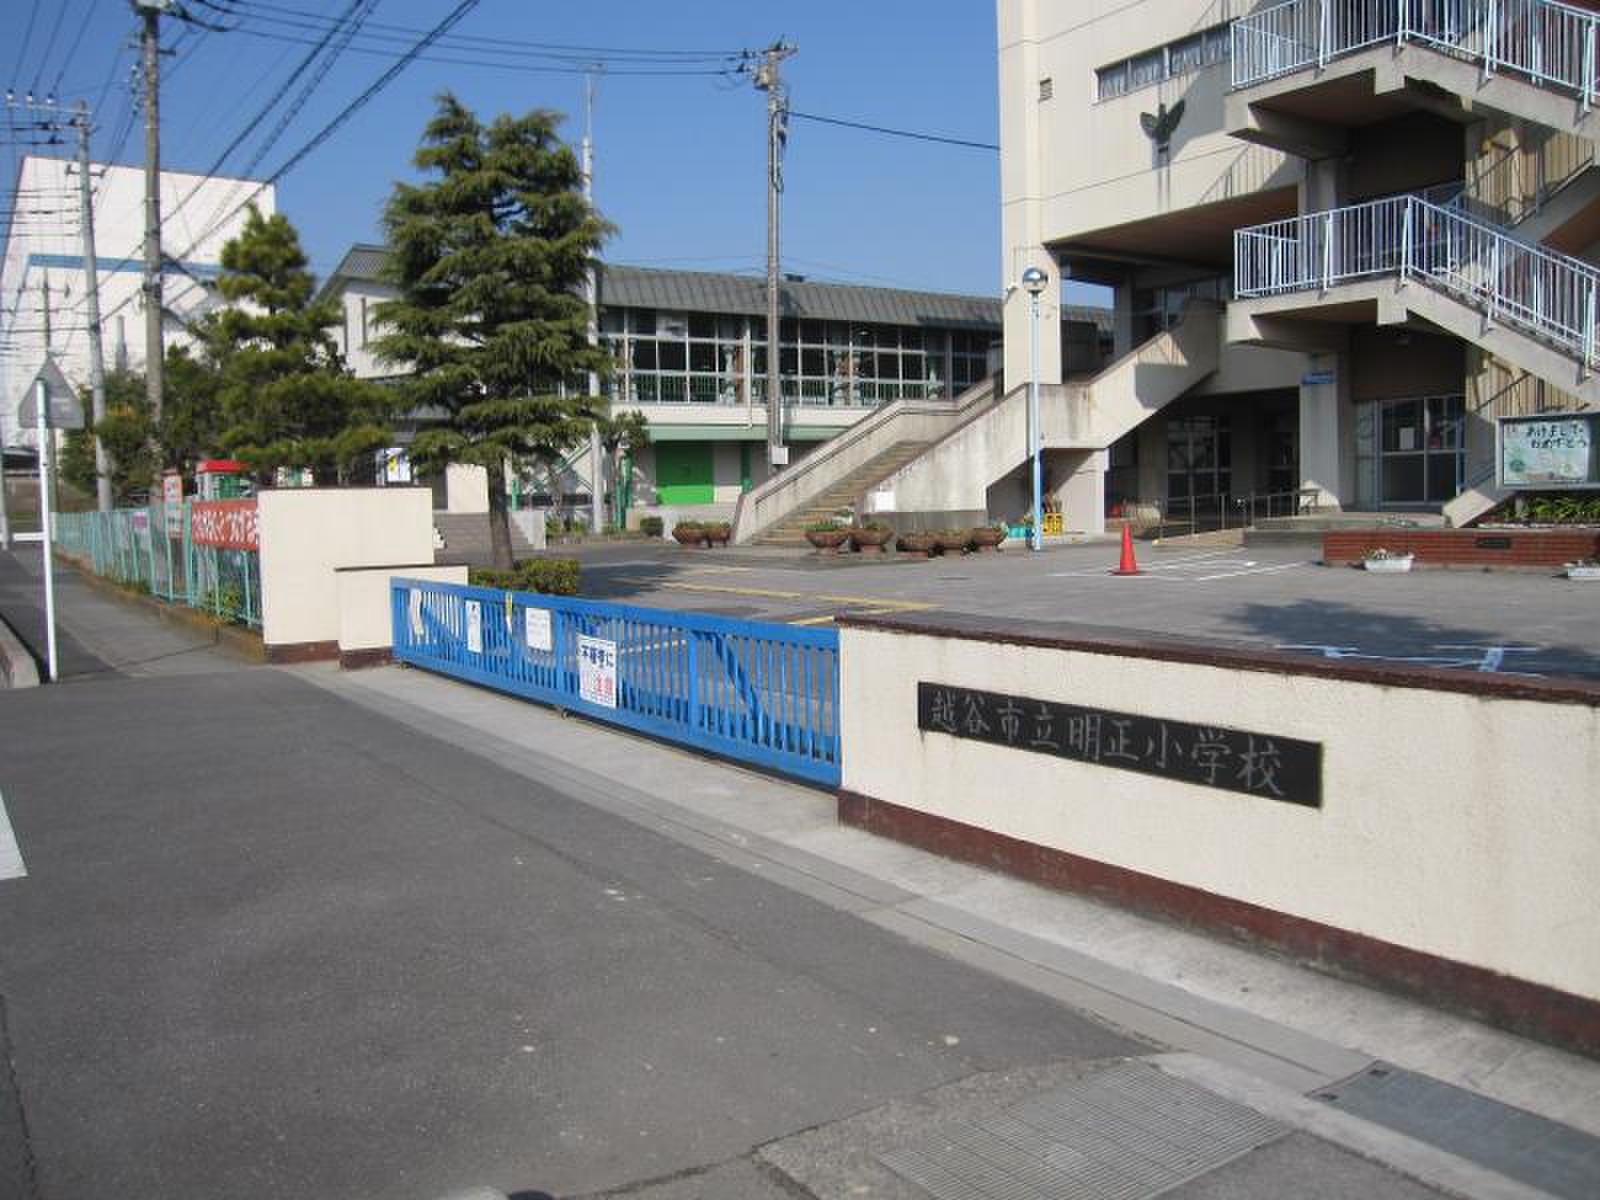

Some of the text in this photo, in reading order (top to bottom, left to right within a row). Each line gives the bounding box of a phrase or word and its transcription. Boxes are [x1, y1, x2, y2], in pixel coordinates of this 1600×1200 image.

[931, 688, 1284, 796] 越谷市立明正小学校
